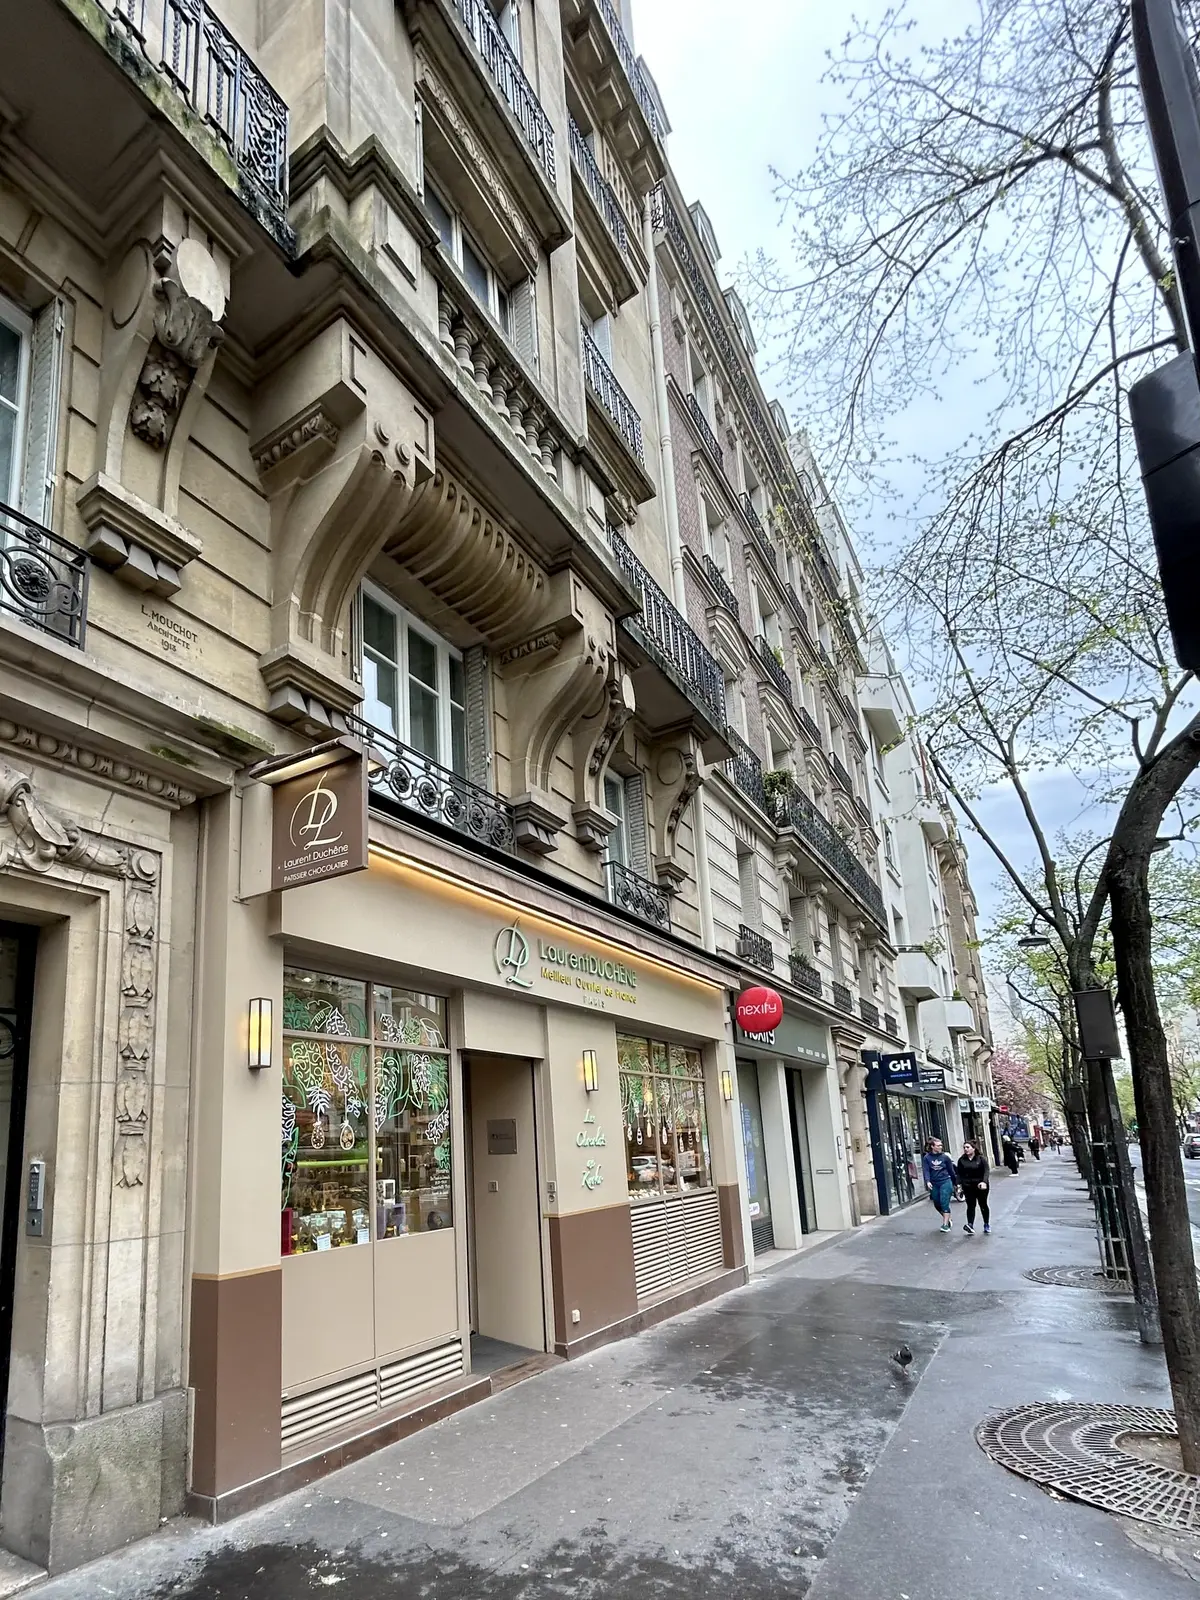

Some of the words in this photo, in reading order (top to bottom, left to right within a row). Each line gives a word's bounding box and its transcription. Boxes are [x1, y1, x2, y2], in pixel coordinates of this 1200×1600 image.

[147, 621, 190, 650] ARCHITECTE
[161, 639, 177, 652] 1913
[284, 851, 312, 868] Laurent
[313, 844, 349, 860] Duchêne
[308, 859, 349, 877] CHOCOLATIER
[541, 967, 572, 986] Meilleur
[576, 976, 602, 994] Ouvrier
[738, 1002, 777, 1016] nexity
[889, 1059, 912, 1072] GH
